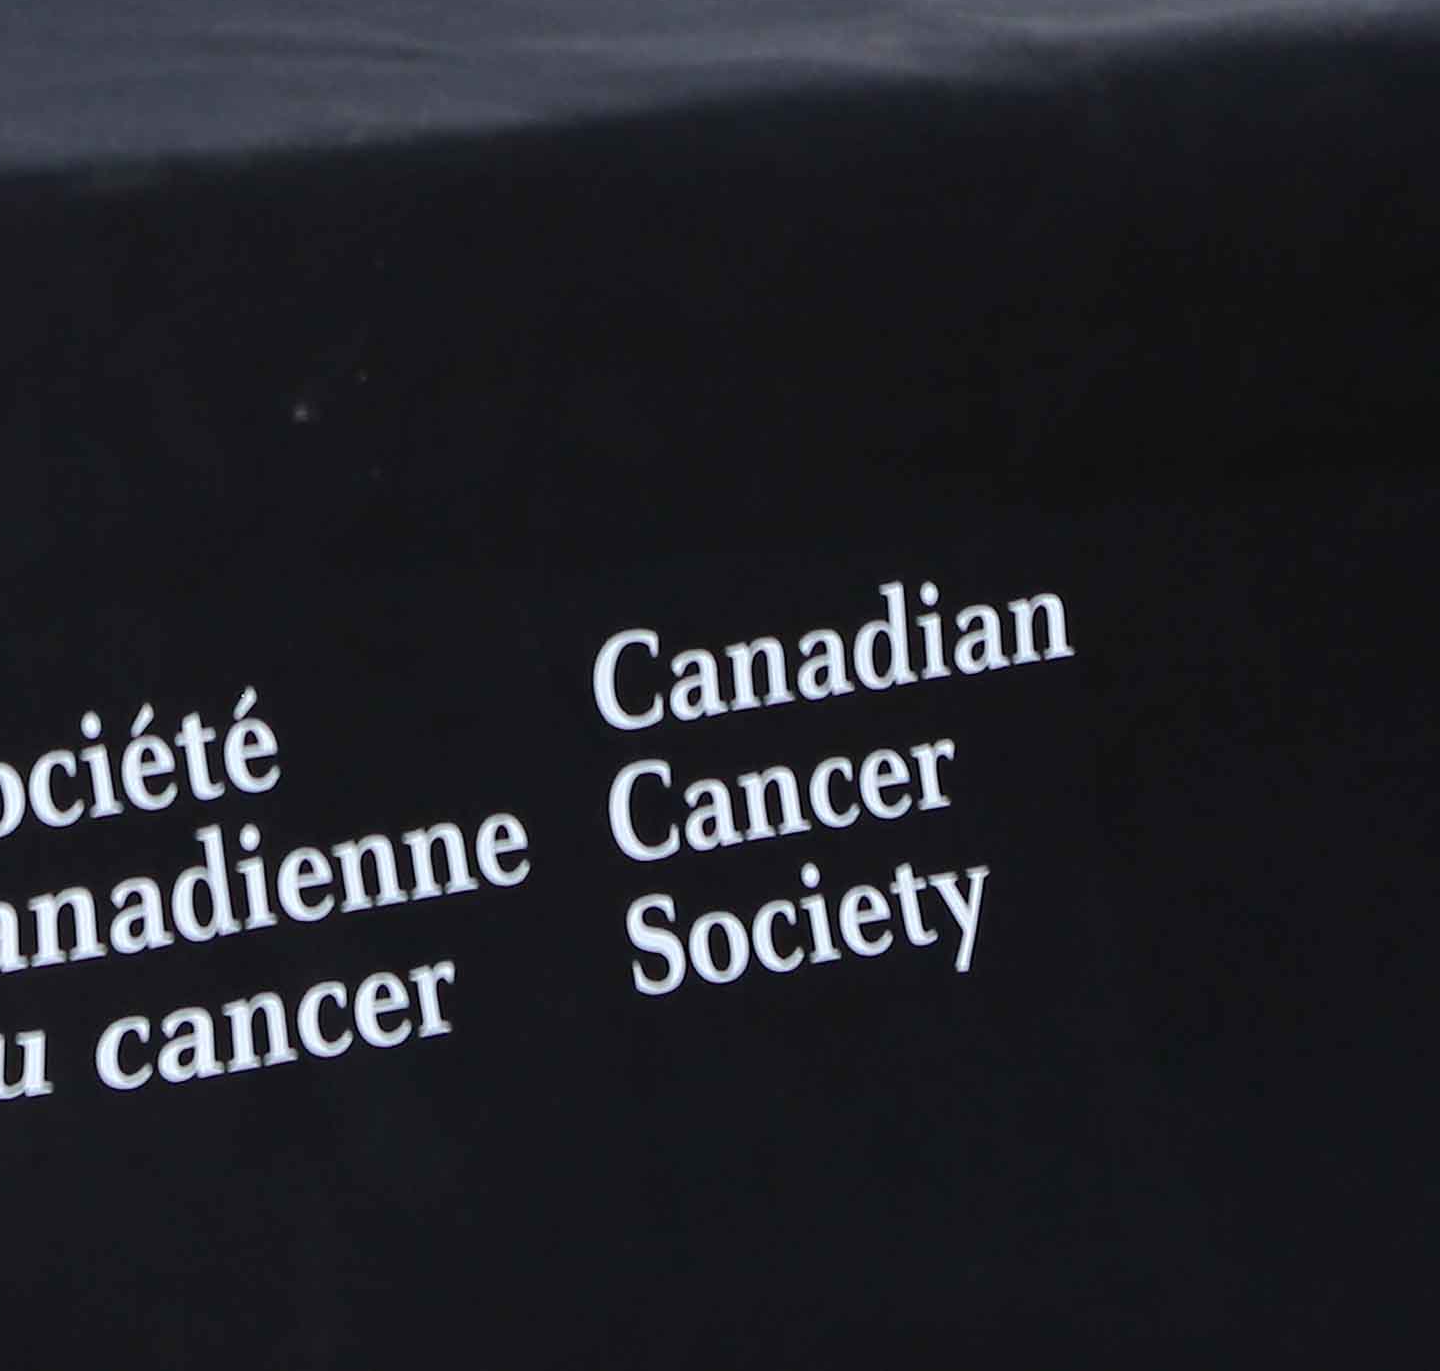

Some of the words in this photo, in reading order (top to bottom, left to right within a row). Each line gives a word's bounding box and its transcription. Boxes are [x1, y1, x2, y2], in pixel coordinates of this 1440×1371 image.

[592, 581, 1075, 731] Canadian
[608, 738, 956, 861] Cancer
[625, 862, 990, 995] Society
[95, 960, 455, 1090] cancer
